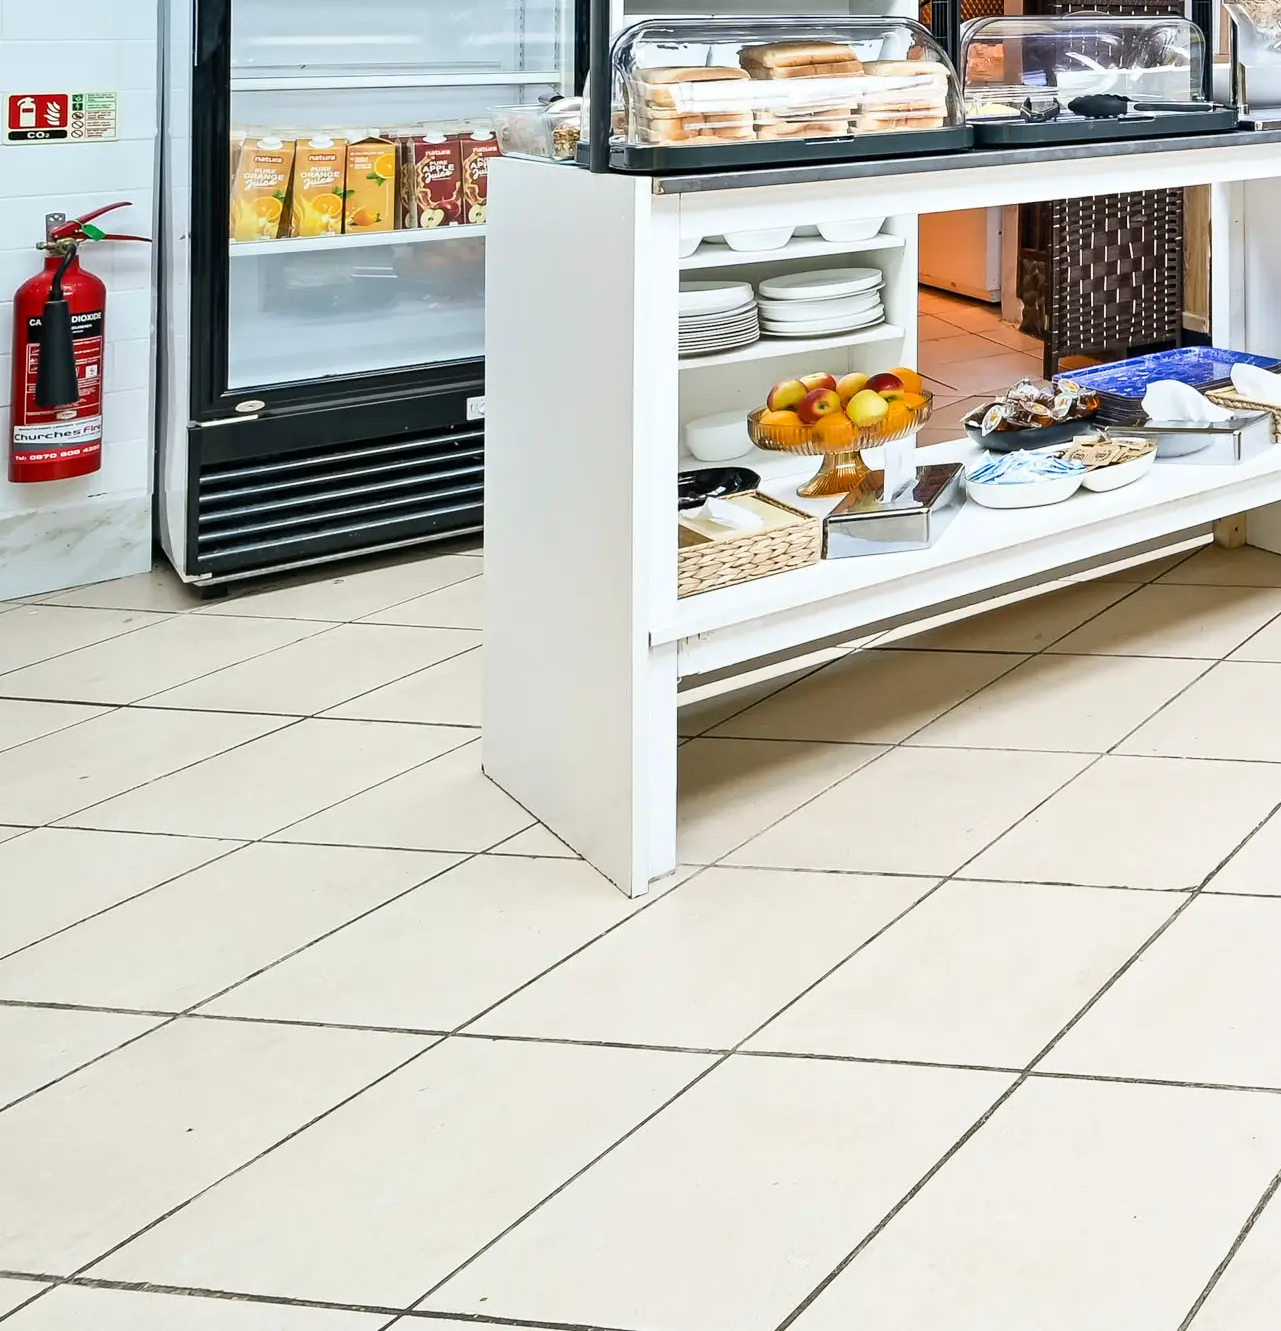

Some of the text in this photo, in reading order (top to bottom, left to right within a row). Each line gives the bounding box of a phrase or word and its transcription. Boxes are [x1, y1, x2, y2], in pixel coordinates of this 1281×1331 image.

[422, 163, 455, 173] APPLE
[300, 171, 341, 179] ORANGE
[71, 312, 102, 323] DIOXIDE
[14, 429, 81, 441] Churches
[29, 452, 57, 461] 0870
